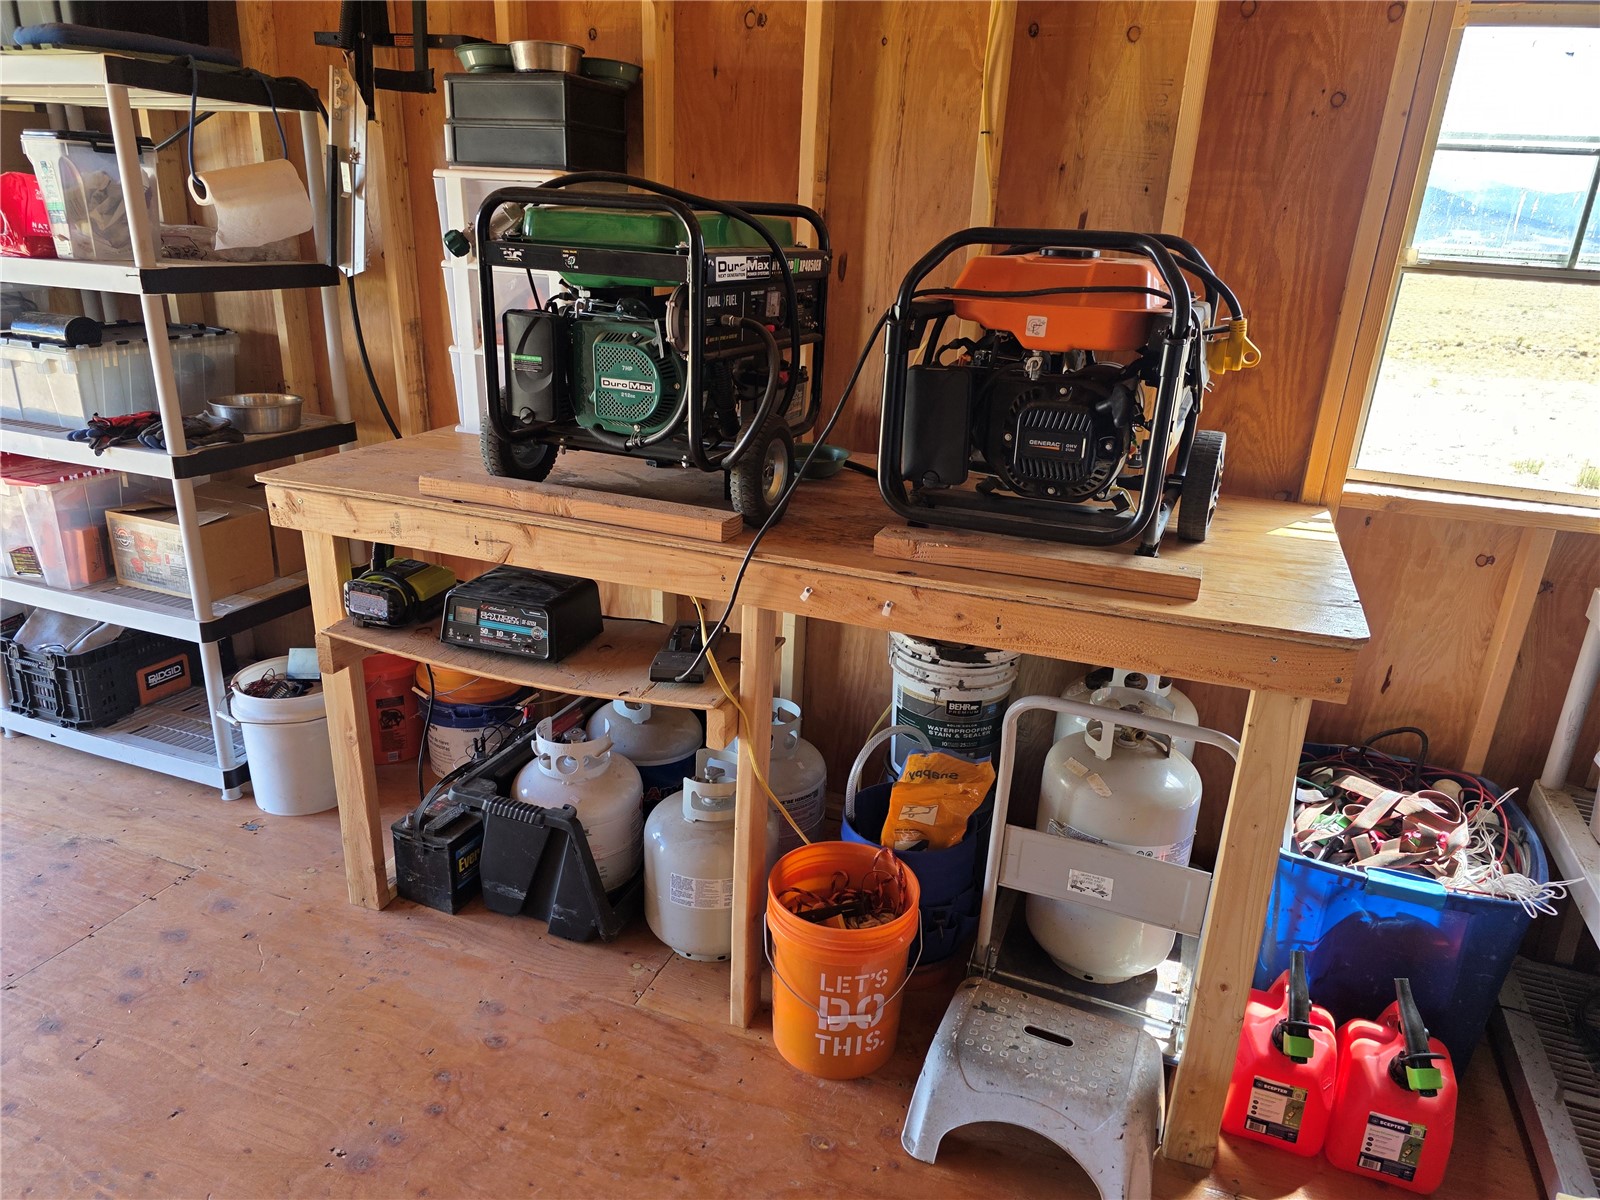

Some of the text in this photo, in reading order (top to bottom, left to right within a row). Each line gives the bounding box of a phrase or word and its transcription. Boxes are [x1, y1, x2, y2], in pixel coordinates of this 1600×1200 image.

[707, 294, 738, 308] DUAL FUEL
[1029, 439, 1061, 447] GENERAC
[480, 611, 520, 621] BATTERY
[480, 615, 520, 625] CHARGER
[148, 665, 181, 684] RIDGID
[949, 703, 971, 711] BEHR
[927, 724, 993, 734] WATERPROOFING
[962, 730, 991, 738] SEALER
[820, 968, 889, 994] LET'S
[818, 993, 885, 1032] DO
[815, 1030, 885, 1057] THIS.
[1263, 1084, 1288, 1094] SCEPTER
[1379, 1120, 1406, 1131] SCEPTER
